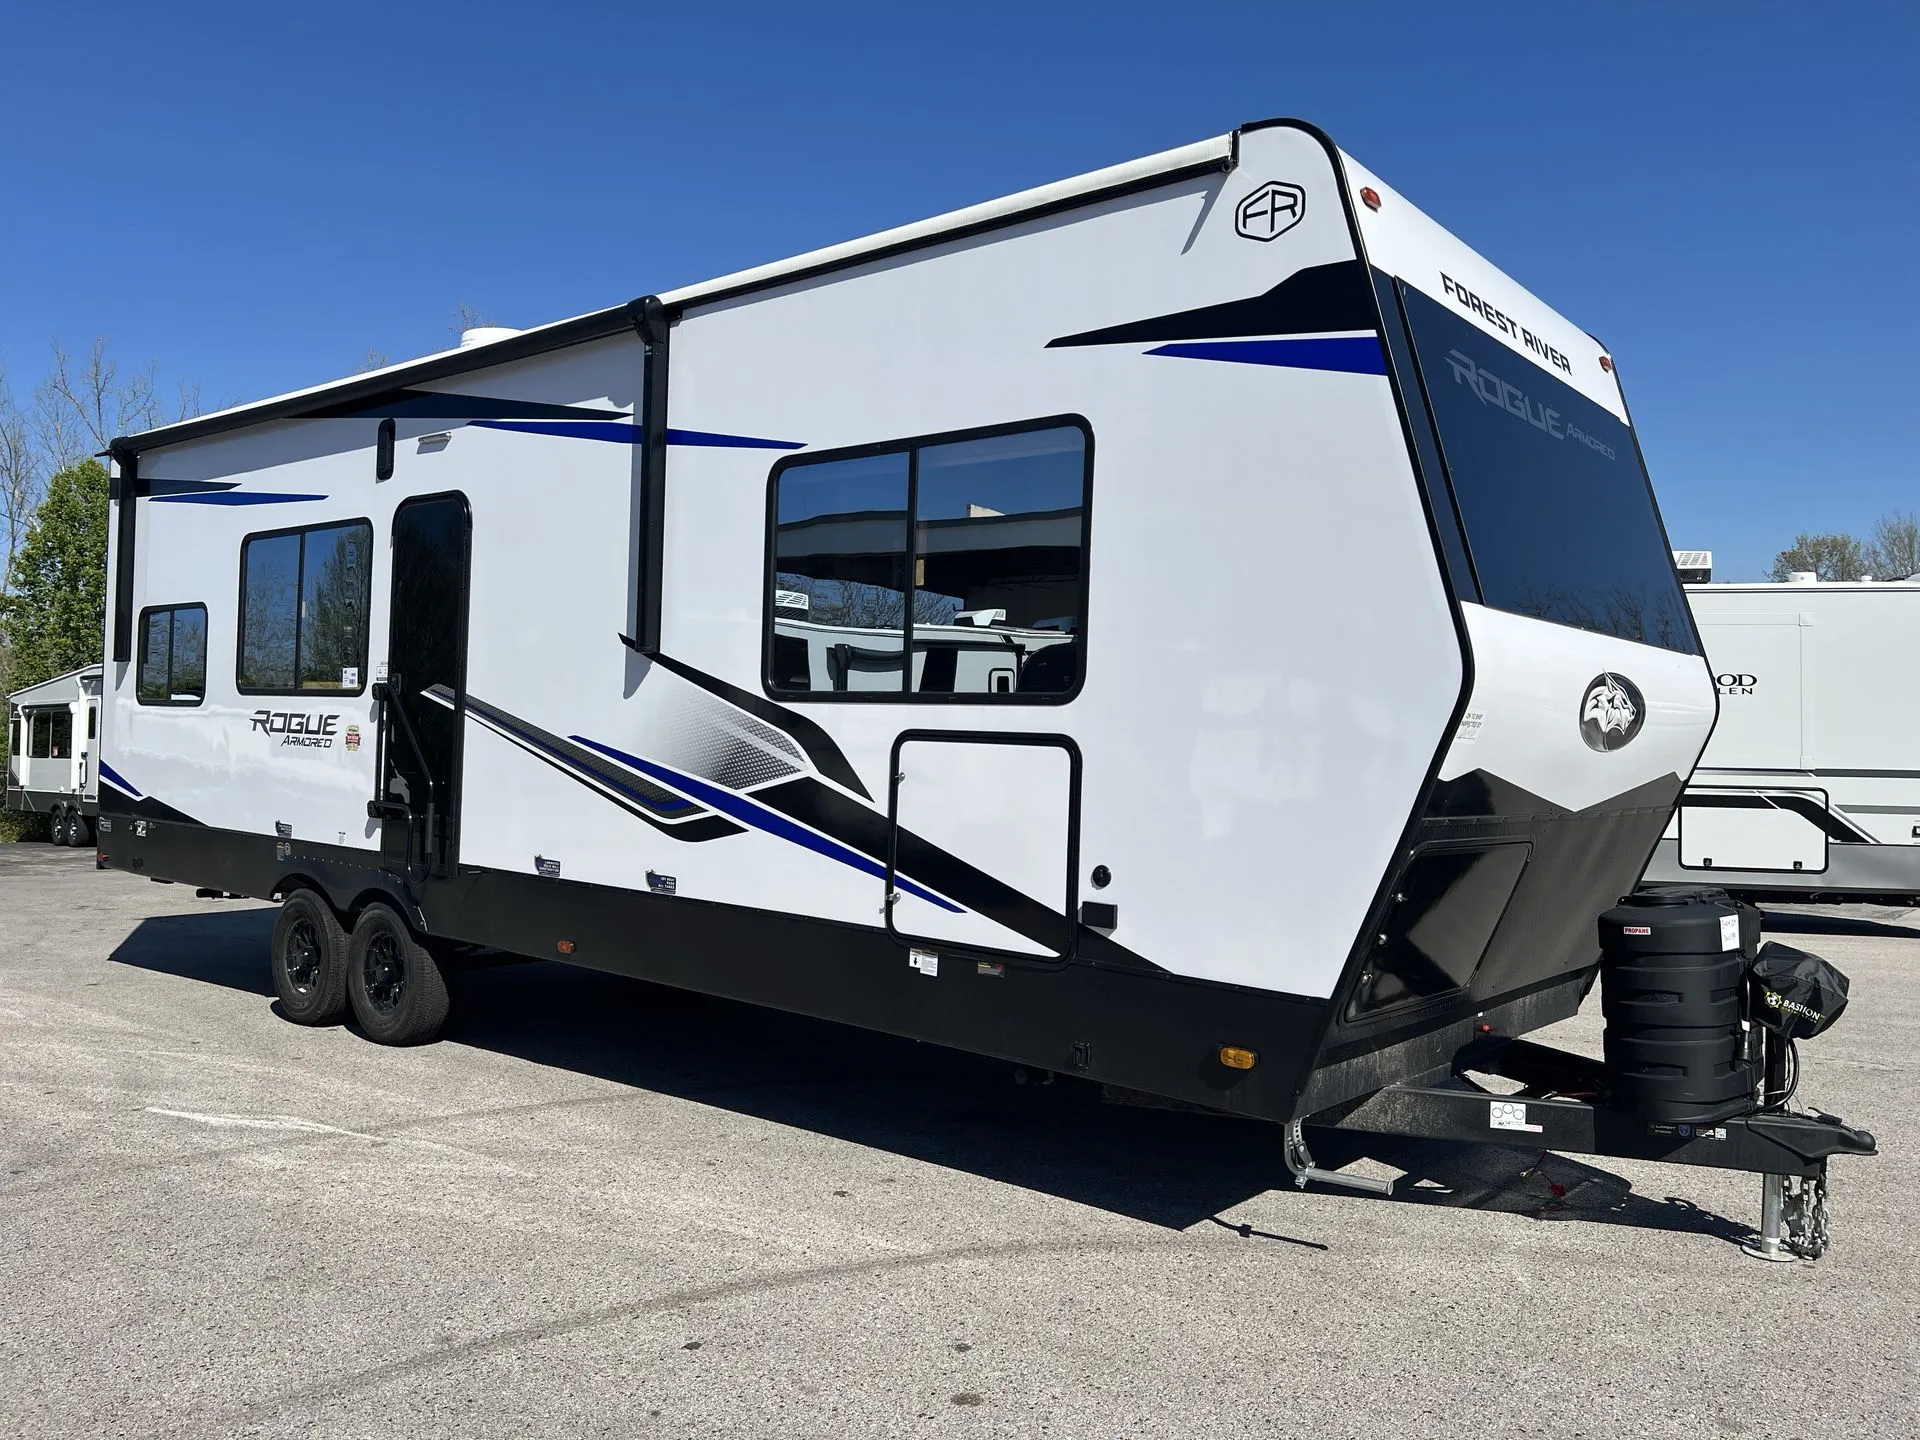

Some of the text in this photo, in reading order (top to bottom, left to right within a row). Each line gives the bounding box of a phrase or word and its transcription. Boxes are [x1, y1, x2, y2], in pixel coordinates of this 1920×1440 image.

[1243, 189, 1298, 233] FR
[1440, 271, 1572, 376] FOREST RIVER
[1444, 349, 1616, 461] ROGUE ARMORED
[1713, 673, 1758, 687] OD
[249, 709, 341, 738] ROGUE
[281, 734, 333, 748] ARMORED
[1783, 999, 1821, 1021] BASTION
